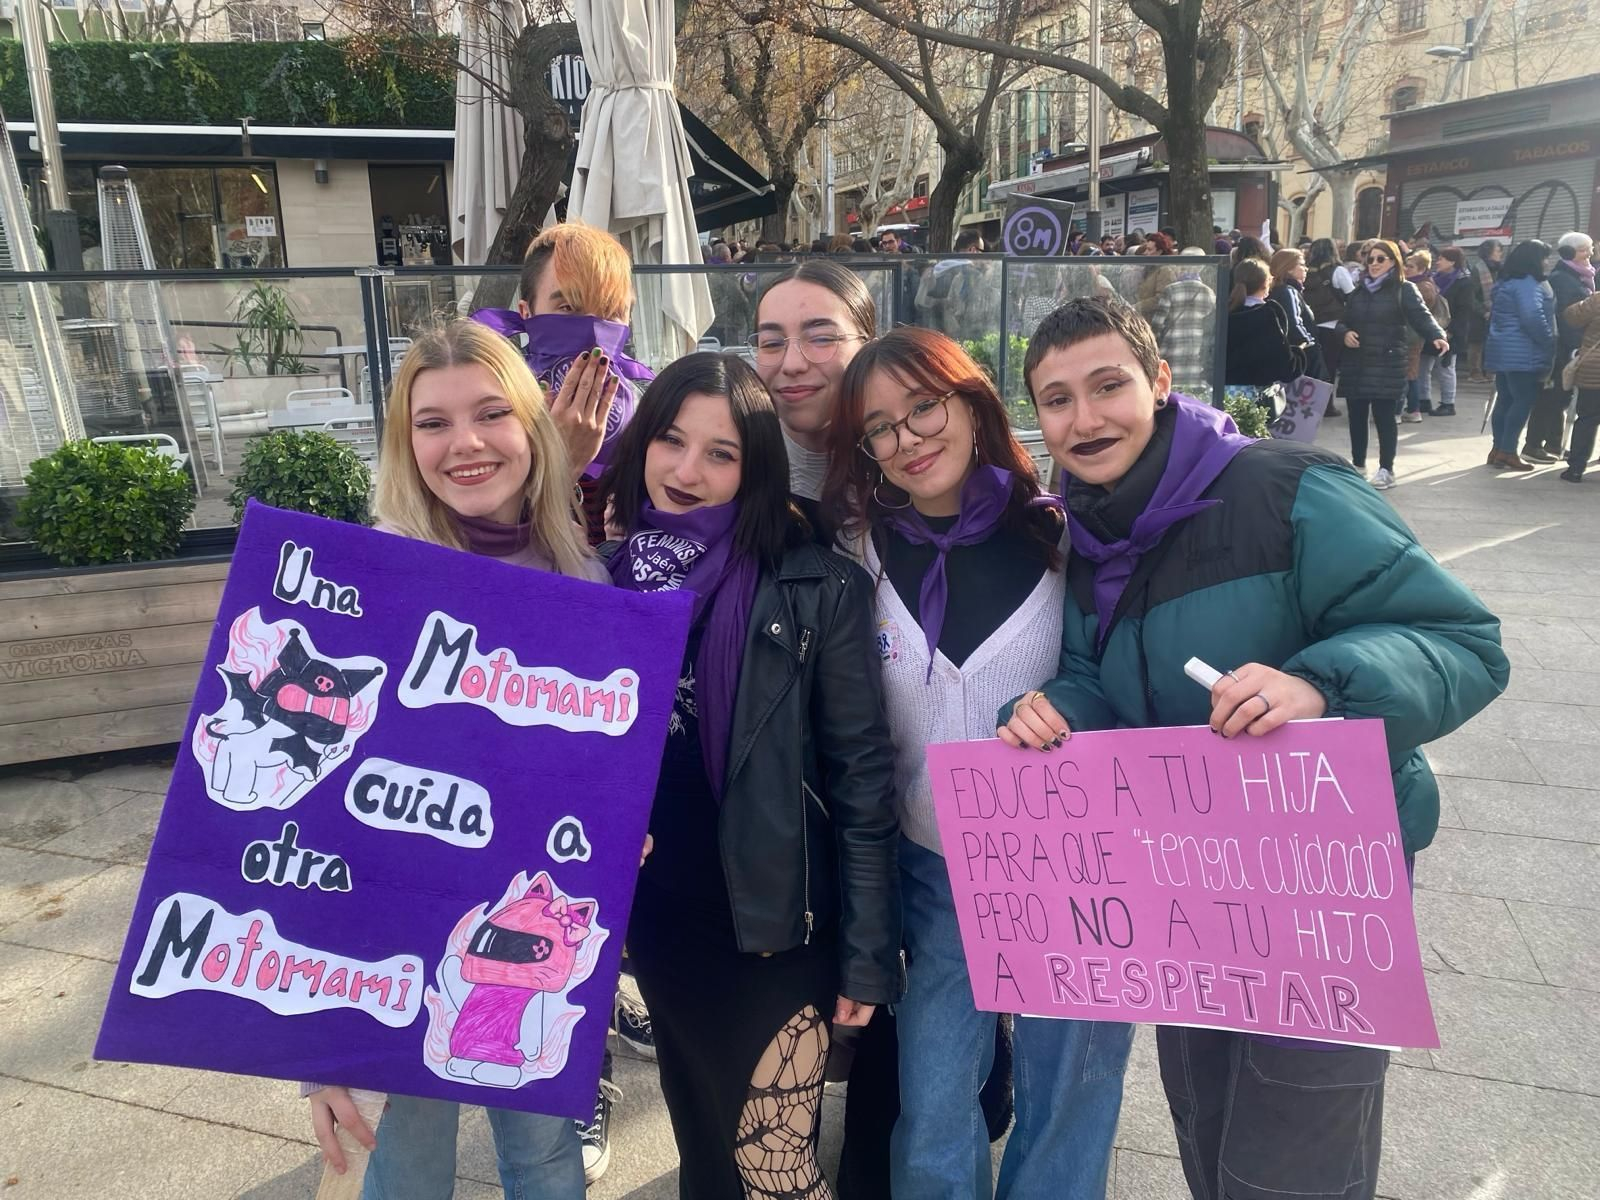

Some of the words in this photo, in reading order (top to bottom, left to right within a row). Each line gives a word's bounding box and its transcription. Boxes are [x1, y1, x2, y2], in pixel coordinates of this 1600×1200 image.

[1407, 158, 1470, 176] ESTANCO
[1513, 140, 1591, 161] TABACOS
[1014, 217, 1052, 250] 8M
[276, 543, 361, 616] Una
[647, 551, 676, 572] Jaén
[0, 649, 148, 679] VICTORIA
[9, 633, 133, 658] CERVEZAS
[409, 617, 634, 723] Motomami
[352, 773, 488, 838] cuida
[951, 760, 1089, 820] EDUCAS
[1114, 756, 1142, 817] A
[1148, 755, 1213, 814] TU
[1238, 751, 1354, 815] HIJA
[243, 822, 352, 891] otra
[553, 822, 588, 857] a
[962, 831, 1057, 882] PARA
[1062, 831, 1127, 884] QUE
[137, 900, 417, 1012] Motomami
[974, 893, 1049, 944] PERO
[1069, 895, 1134, 949] NO
[1167, 899, 1201, 950] A
[1213, 901, 1271, 959] TU
[1294, 908, 1394, 972] HIJO
[994, 952, 1025, 1004] A
[1044, 953, 1376, 1035] RESPETAR
